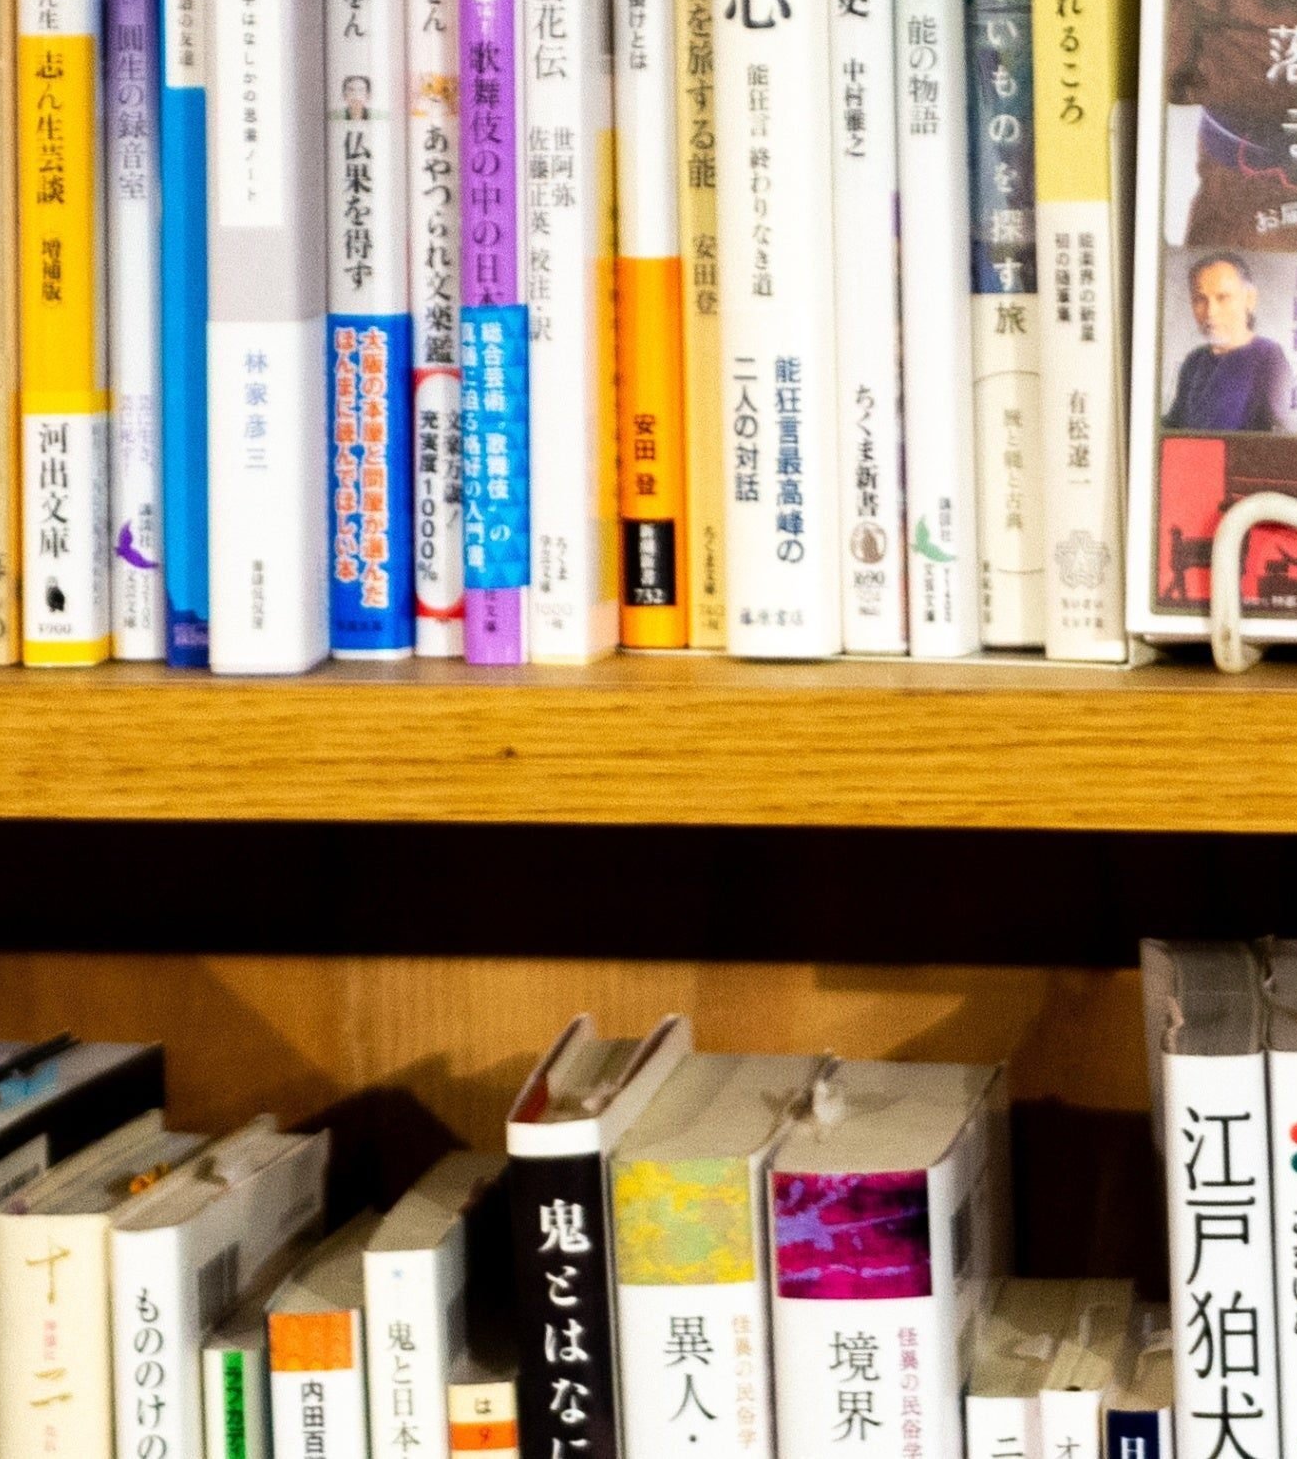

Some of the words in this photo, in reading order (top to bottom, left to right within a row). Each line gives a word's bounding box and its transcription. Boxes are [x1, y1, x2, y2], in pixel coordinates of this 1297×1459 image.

[35, 49, 66, 205] 志ん生芸談
[906, 14, 940, 137] 能の物語
[551, 125, 576, 209] 世阿弥
[421, 124, 456, 364] あやつられ文楽鑑
[243, 348, 269, 471] 林家彦三
[732, 355, 760, 503] 二人の対話
[773, 355, 806, 565] 能狂言最高峰の
[38, 421, 71, 561] 河出文庫
[1181, 1106, 1265, 1459] 江戸狛犬
[131, 1287, 168, 1459] もののけの
[386, 1319, 422, 1453] 鬼と日本
[827, 1331, 883, 1442] 境界
